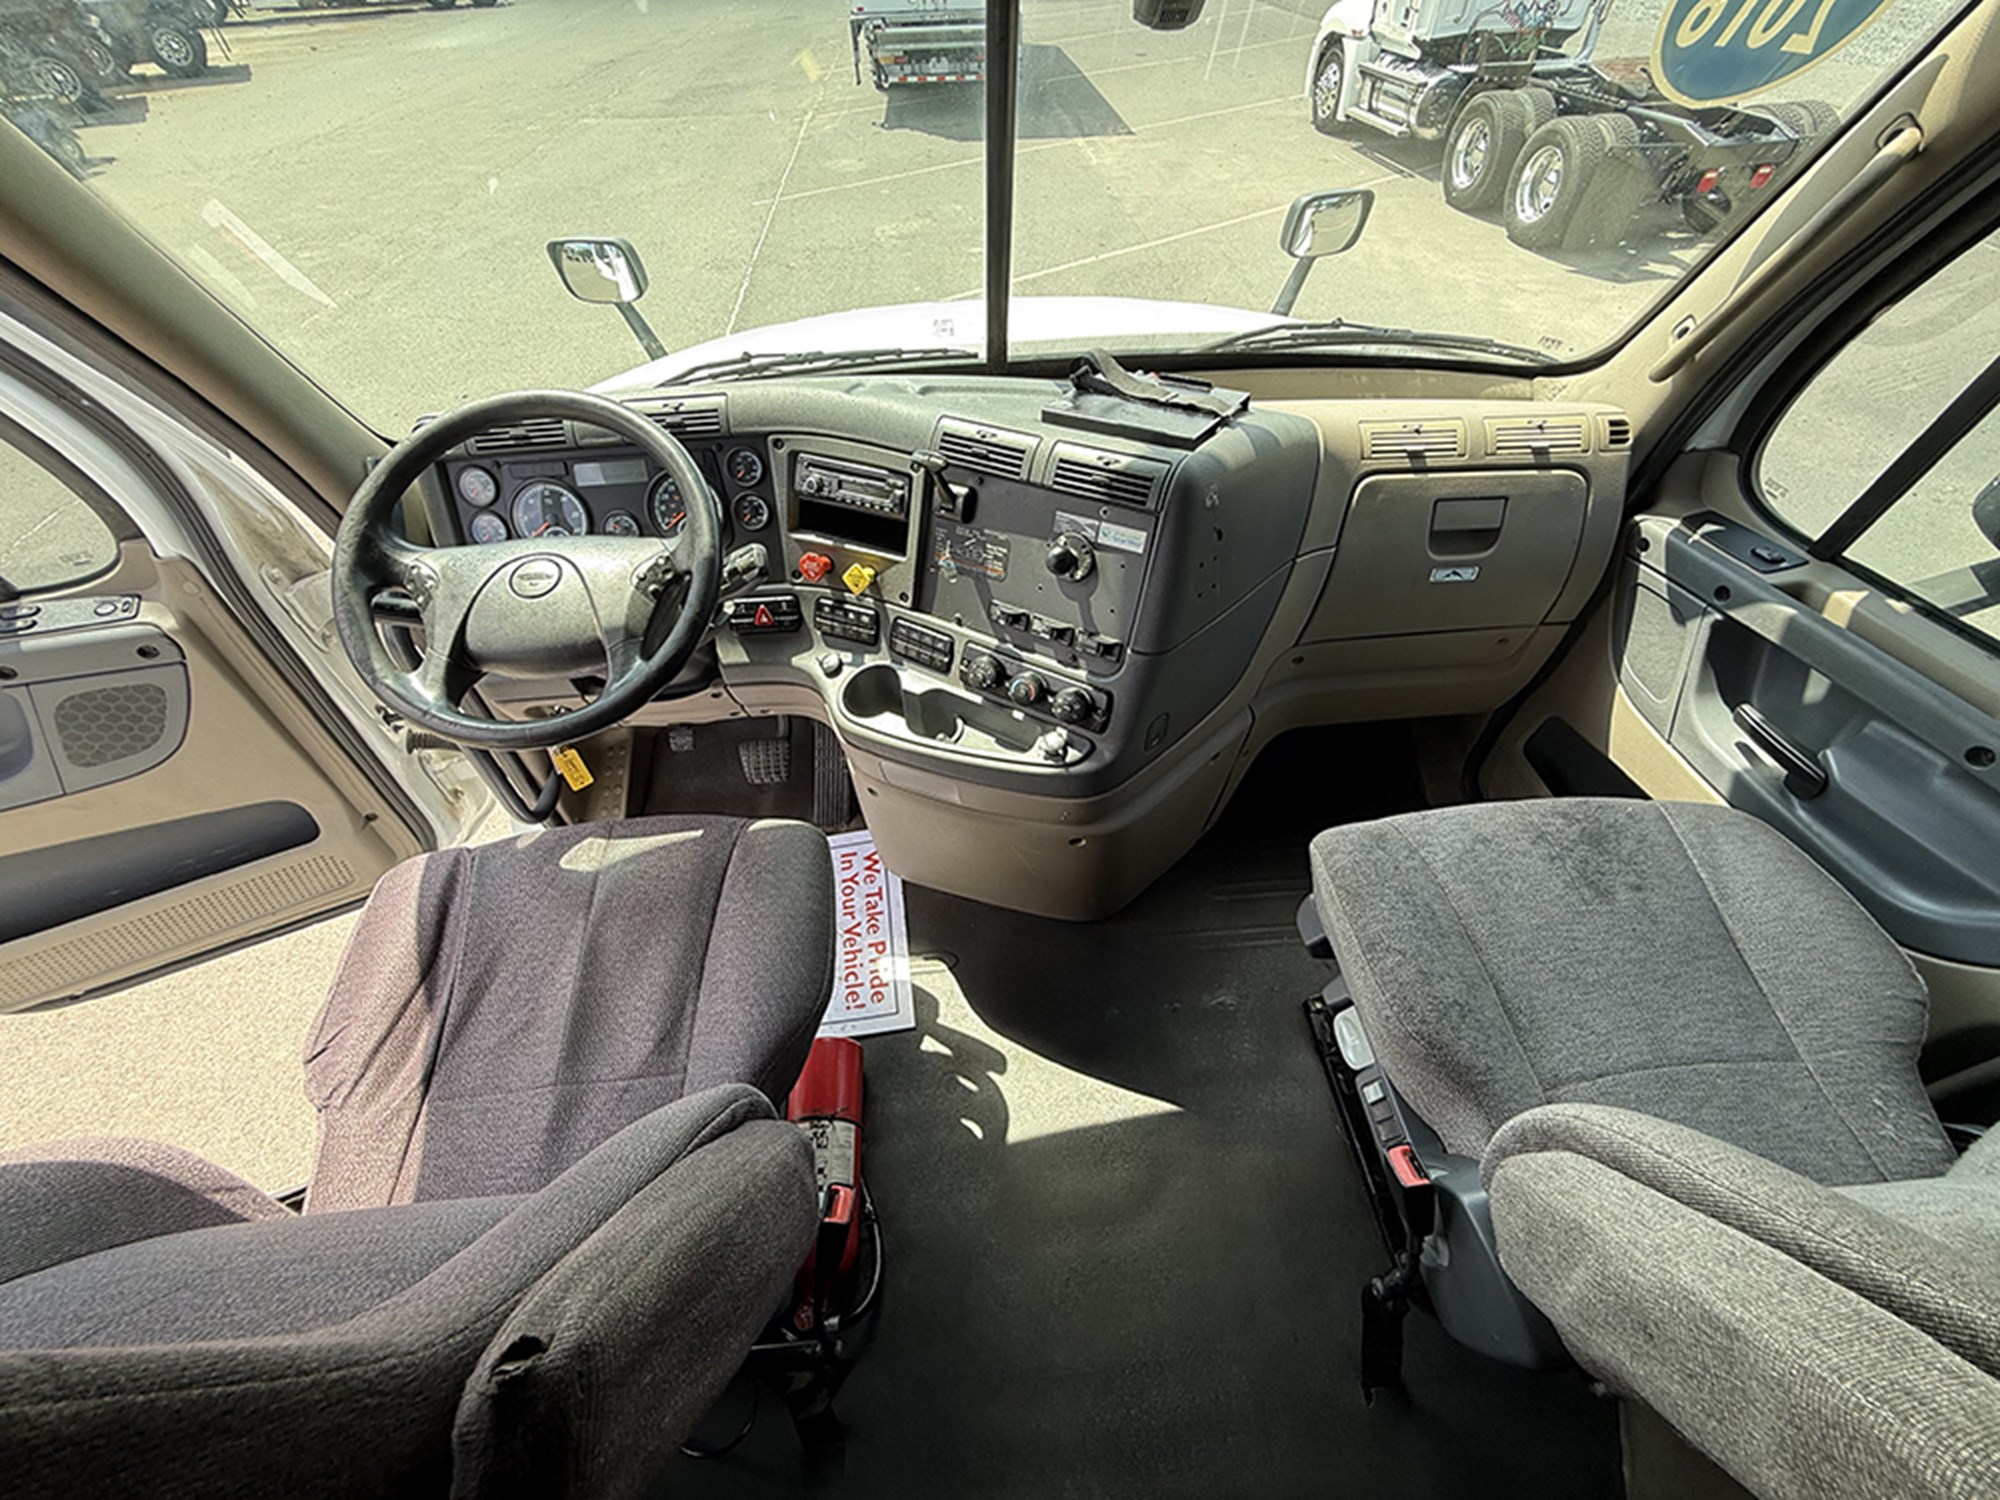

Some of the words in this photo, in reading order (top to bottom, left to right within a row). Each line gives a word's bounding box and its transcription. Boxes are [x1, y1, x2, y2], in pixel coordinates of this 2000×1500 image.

[840, 851, 858, 872] In
[862, 851, 882, 885] We
[841, 873, 860, 920] Your
[865, 886, 884, 935] Take
[843, 921, 867, 1011] Vehicle!
